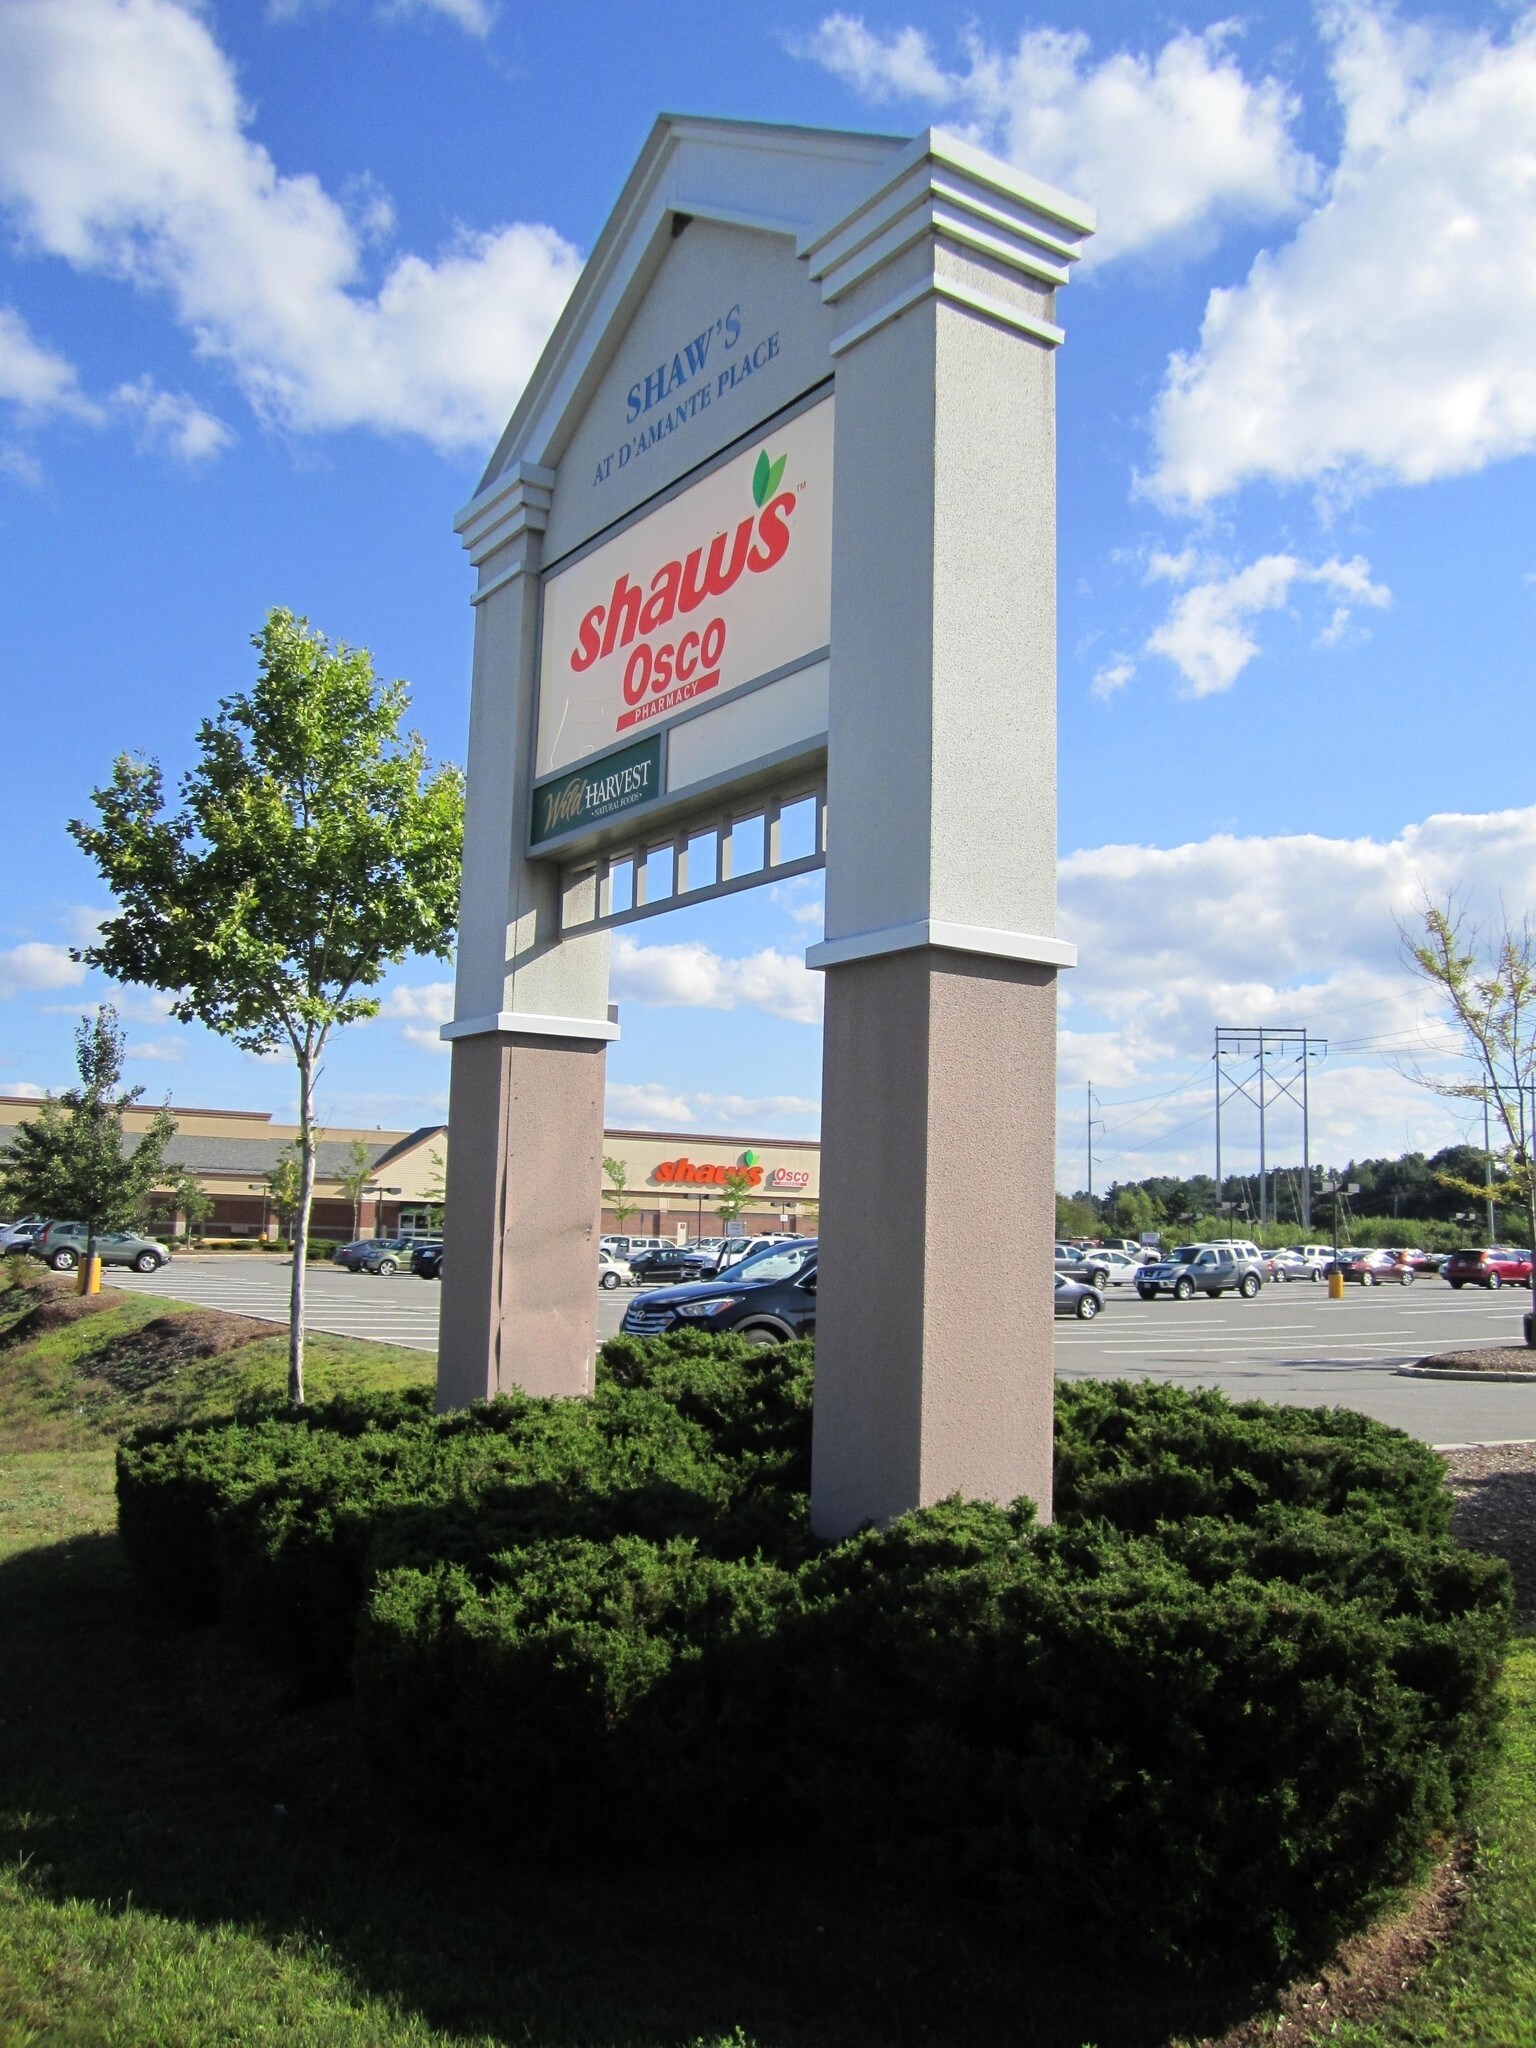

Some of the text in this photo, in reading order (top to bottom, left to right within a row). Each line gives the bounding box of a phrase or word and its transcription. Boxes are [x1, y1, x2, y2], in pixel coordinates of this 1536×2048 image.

[593, 331, 781, 488] AT D'AMANTE PLACE
[626, 304, 741, 425] SHAW'S
[634, 682, 699, 722] PHARMACY
[543, 760, 652, 835] Wild HARVEST
